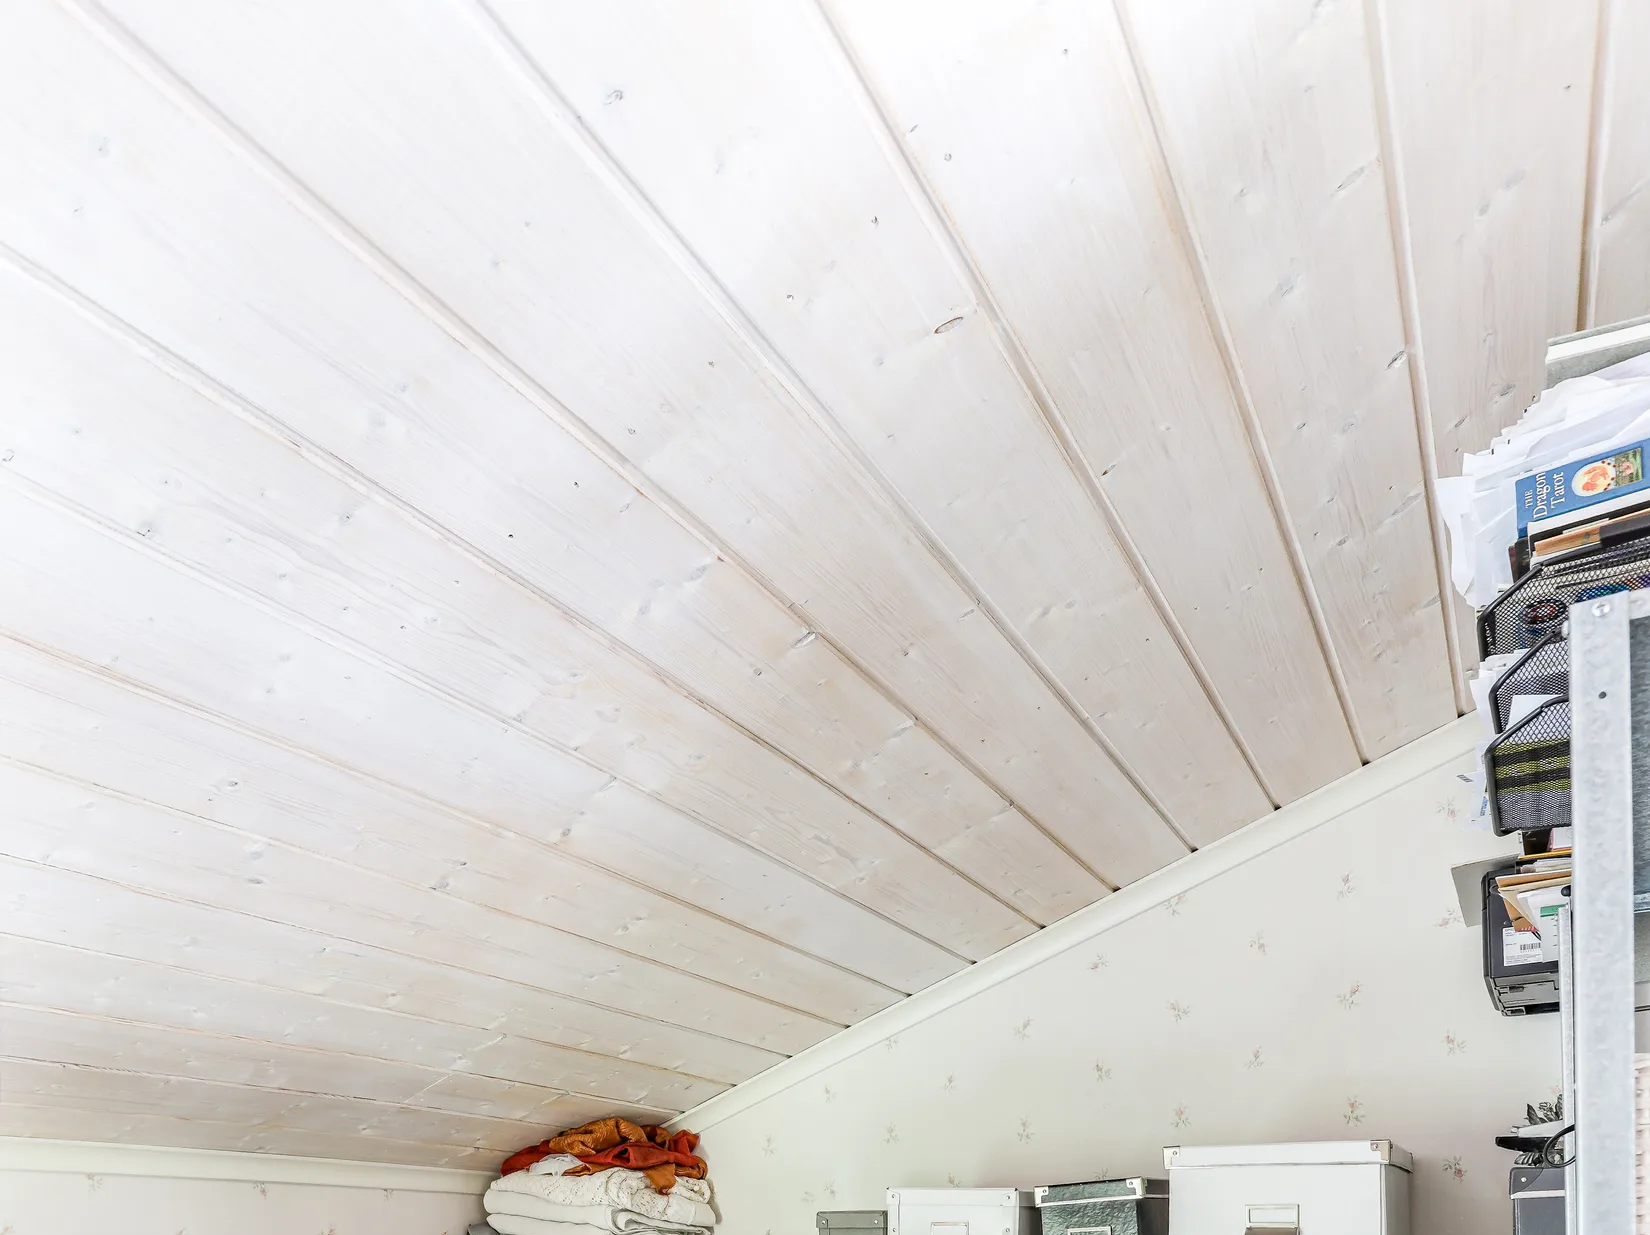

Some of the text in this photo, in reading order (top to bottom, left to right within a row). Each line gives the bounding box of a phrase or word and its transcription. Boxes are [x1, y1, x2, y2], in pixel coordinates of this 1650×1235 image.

[1525, 490, 1533, 509] THE
[1533, 472, 1550, 519] Dragon
[1551, 472, 1566, 509] Tarot
